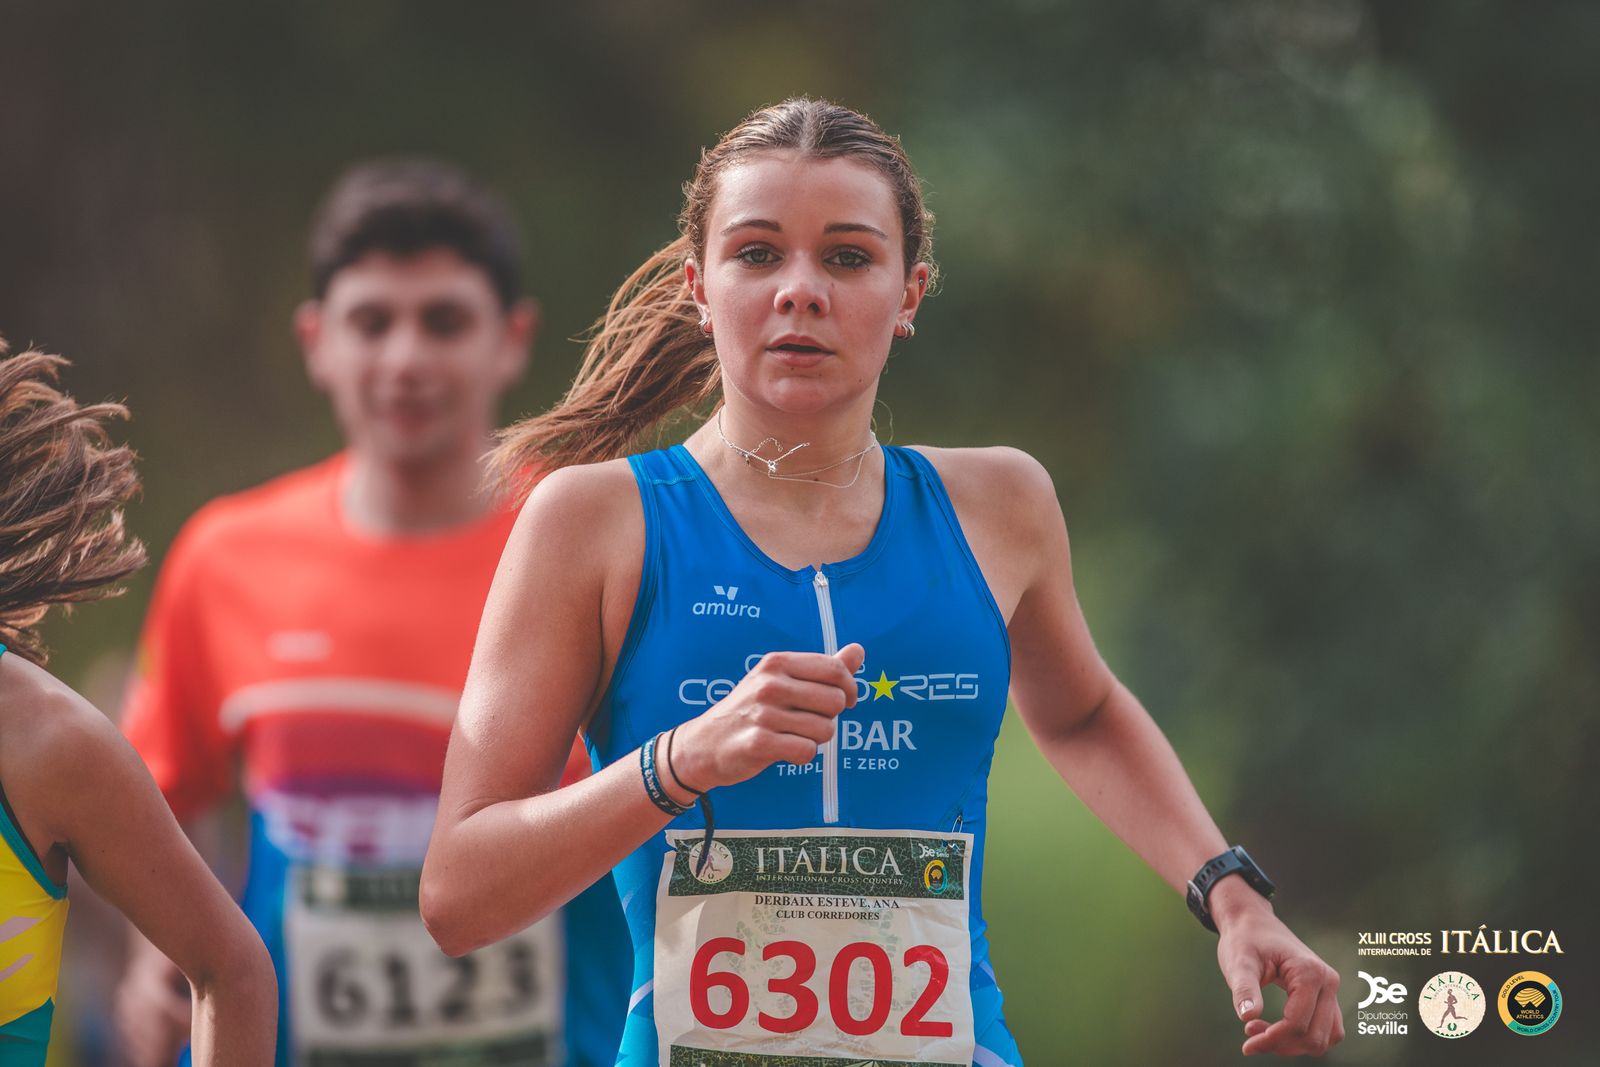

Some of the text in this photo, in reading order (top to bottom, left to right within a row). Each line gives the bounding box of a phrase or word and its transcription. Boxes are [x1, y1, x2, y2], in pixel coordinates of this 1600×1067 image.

[692, 602, 760, 618] amura
[857, 758, 900, 771] ZERO
[754, 839, 904, 876] ITÁLICA
[756, 874, 904, 885] INTERNATIONAL CROSS COUNTRY
[754, 894, 901, 909] DERBAIX ESTEVE, ANA
[776, 910, 880, 920] CLUB CORREDORES
[690, 937, 953, 1037] 6302
